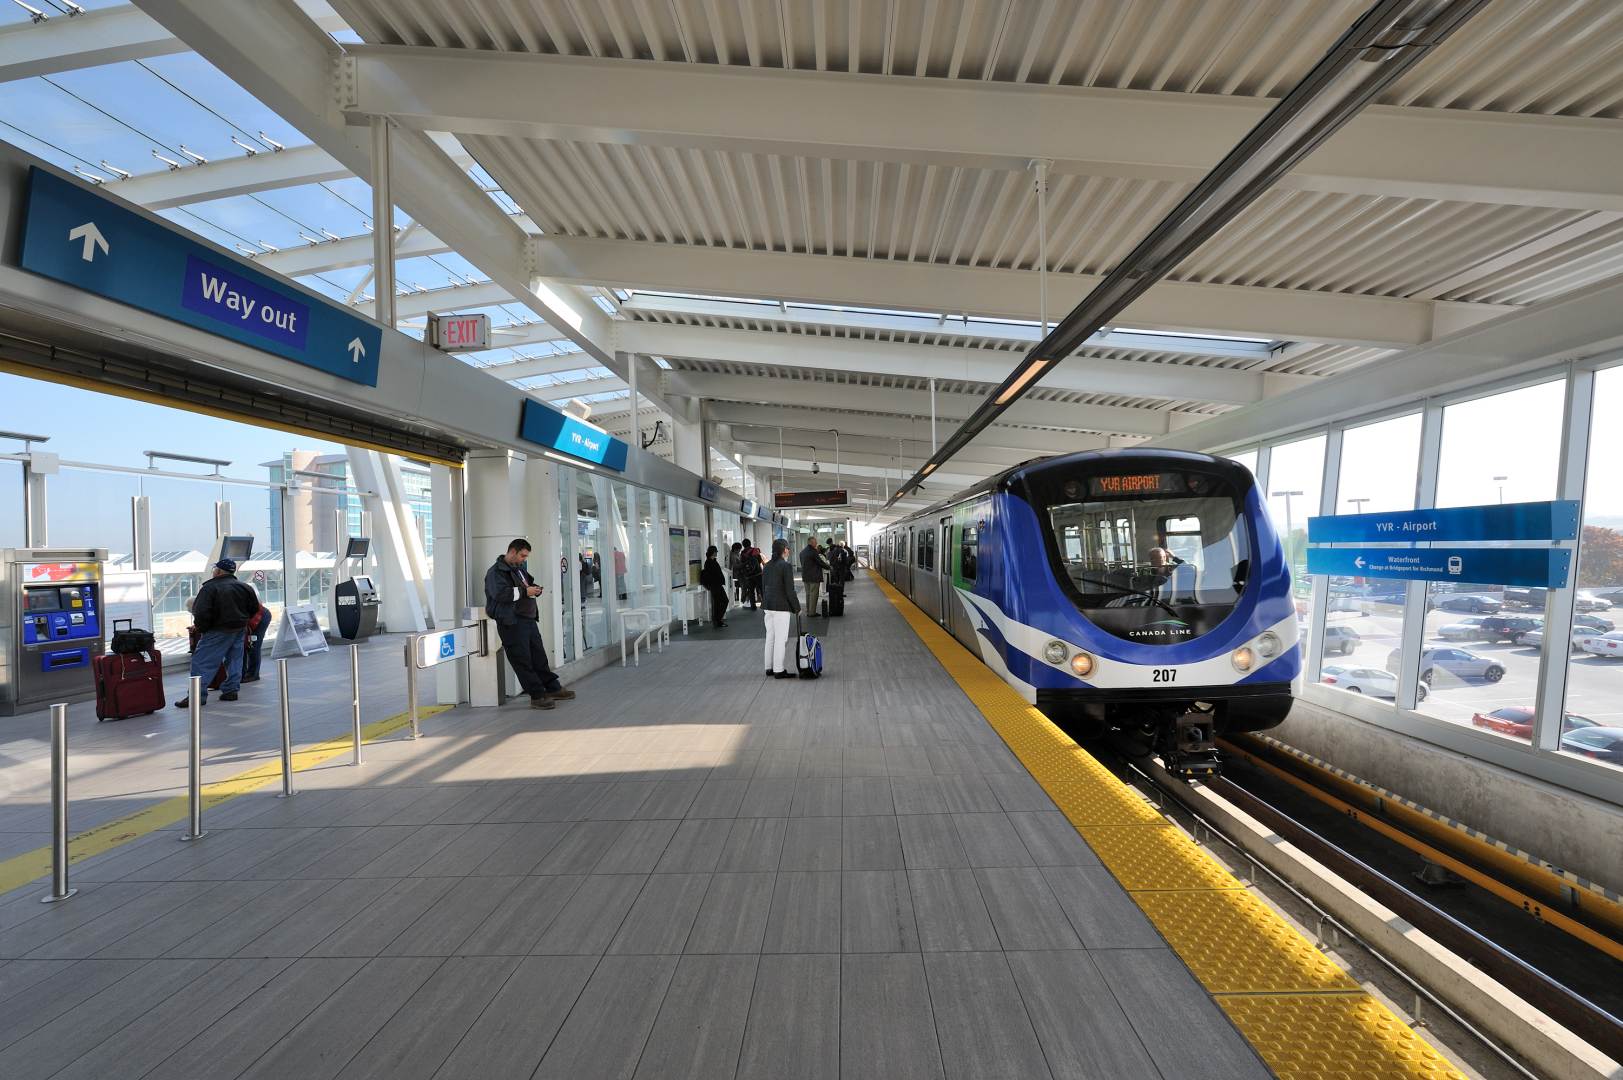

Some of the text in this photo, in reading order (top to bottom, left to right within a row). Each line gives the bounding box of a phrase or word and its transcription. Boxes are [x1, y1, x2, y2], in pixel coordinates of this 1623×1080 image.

[201, 272, 297, 333] Way out
[448, 320, 477, 343] EXIT
[1101, 475, 1160, 491] YVR AIRPORT
[1376, 522, 1394, 532] YVR
[1403, 521, 1437, 533] Airport
[1388, 556, 1420, 564] Waterfront
[1152, 669, 1177, 683] 207
